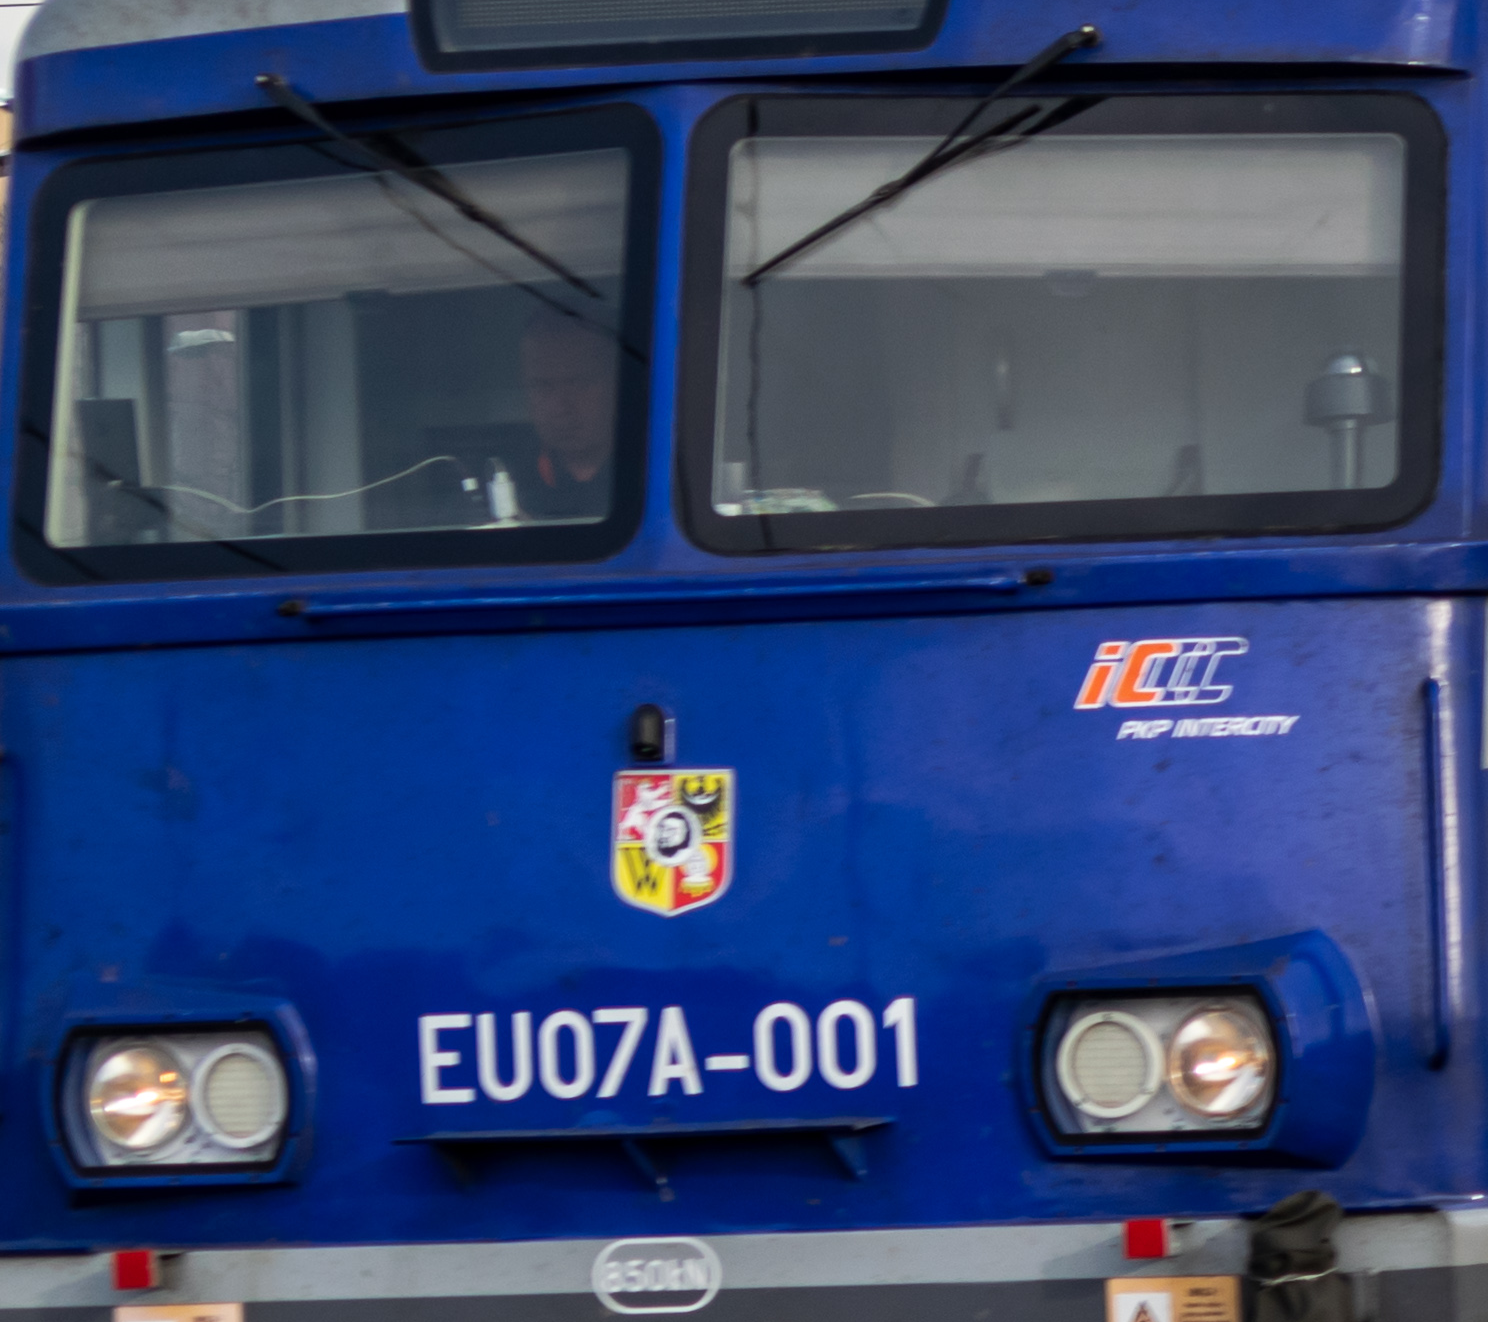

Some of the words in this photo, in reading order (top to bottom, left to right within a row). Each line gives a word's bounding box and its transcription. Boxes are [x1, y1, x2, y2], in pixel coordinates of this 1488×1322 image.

[1118, 719, 1171, 740] PKP
[1173, 714, 1299, 738] INTERCITY
[419, 996, 918, 1105] EU07A-001
